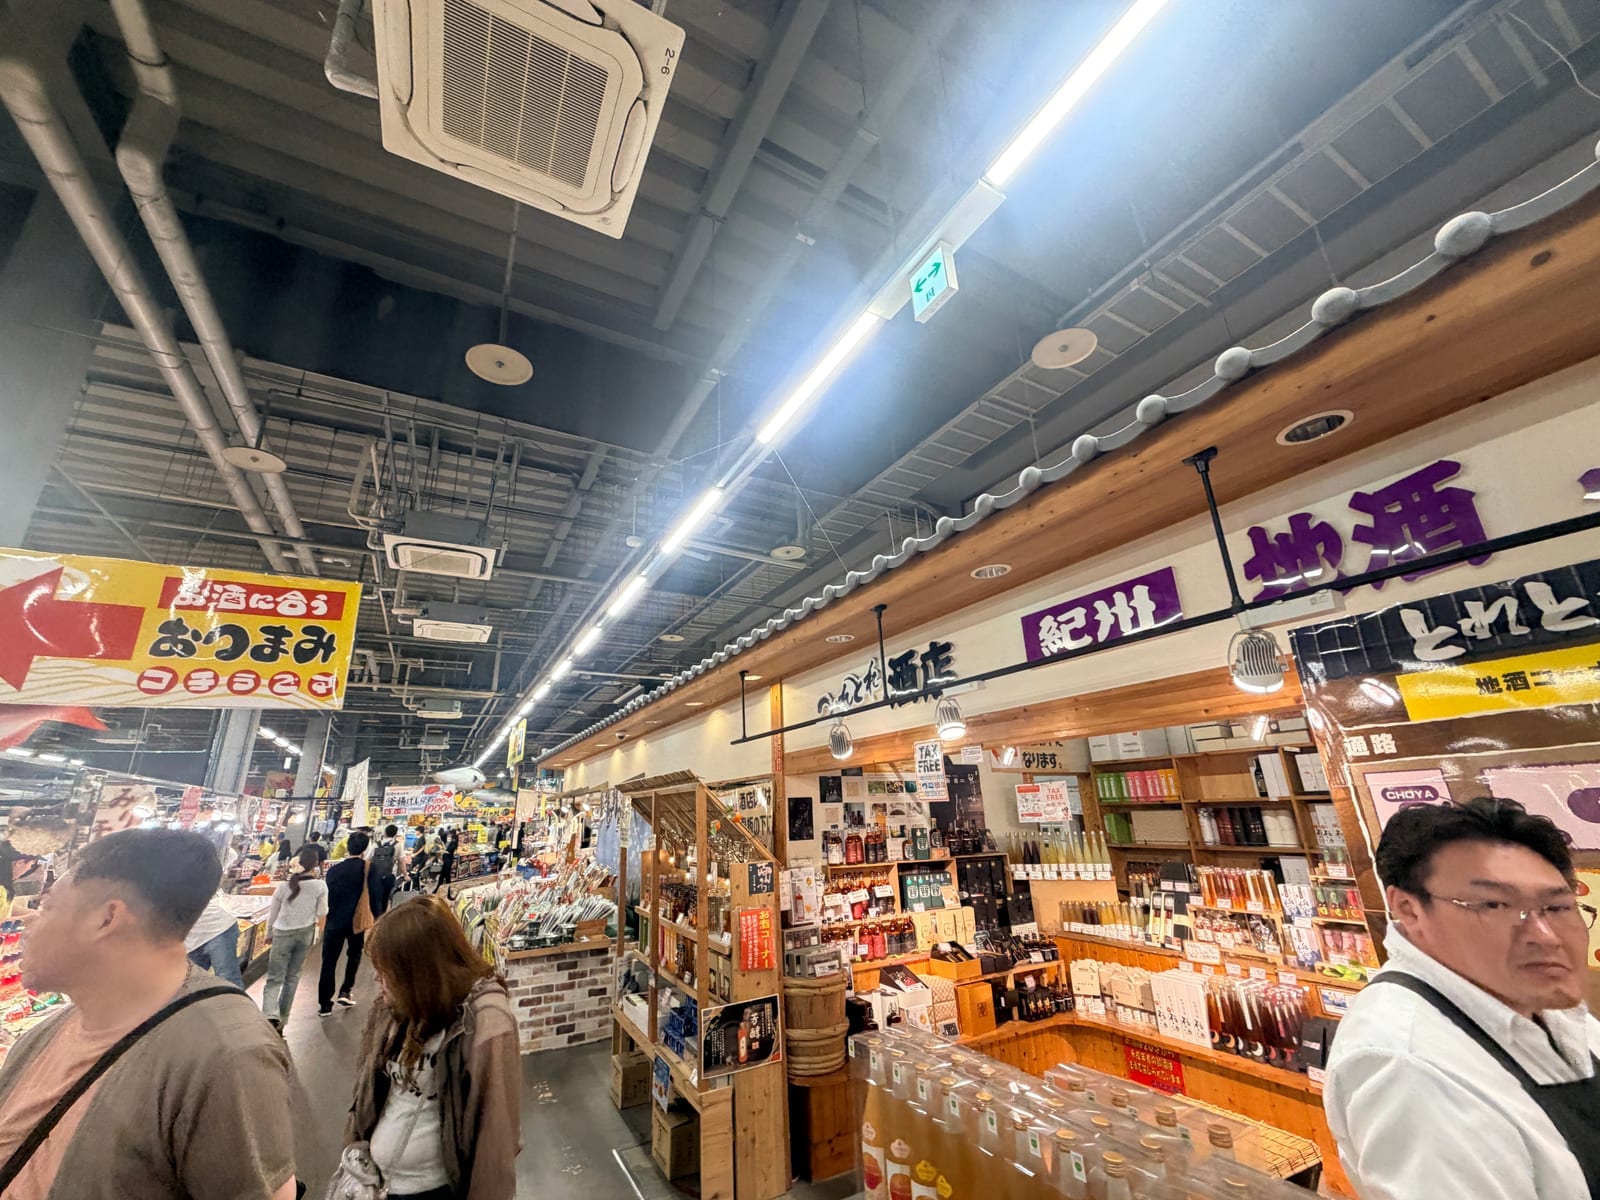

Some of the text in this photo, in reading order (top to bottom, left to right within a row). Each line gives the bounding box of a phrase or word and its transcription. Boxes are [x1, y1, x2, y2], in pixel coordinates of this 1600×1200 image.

[660, 47, 676, 76] 2-6
[1243, 459, 1489, 601] 地酒
[1038, 584, 1156, 657] 紀州
[1399, 580, 1600, 662] とれと
[148, 616, 337, 665] おつまみ
[139, 668, 337, 696] コチラです
[918, 744, 939, 760] TAX
[1343, 732, 1398, 757] 通路
[918, 759, 941, 773] FREE
[1022, 751, 1063, 769] なります。
[739, 786, 771, 810] 酒店レは
[1046, 793, 1064, 801] FREE
[1385, 790, 1435, 801] CHOYA
[759, 910, 771, 969] お酒コーナー
